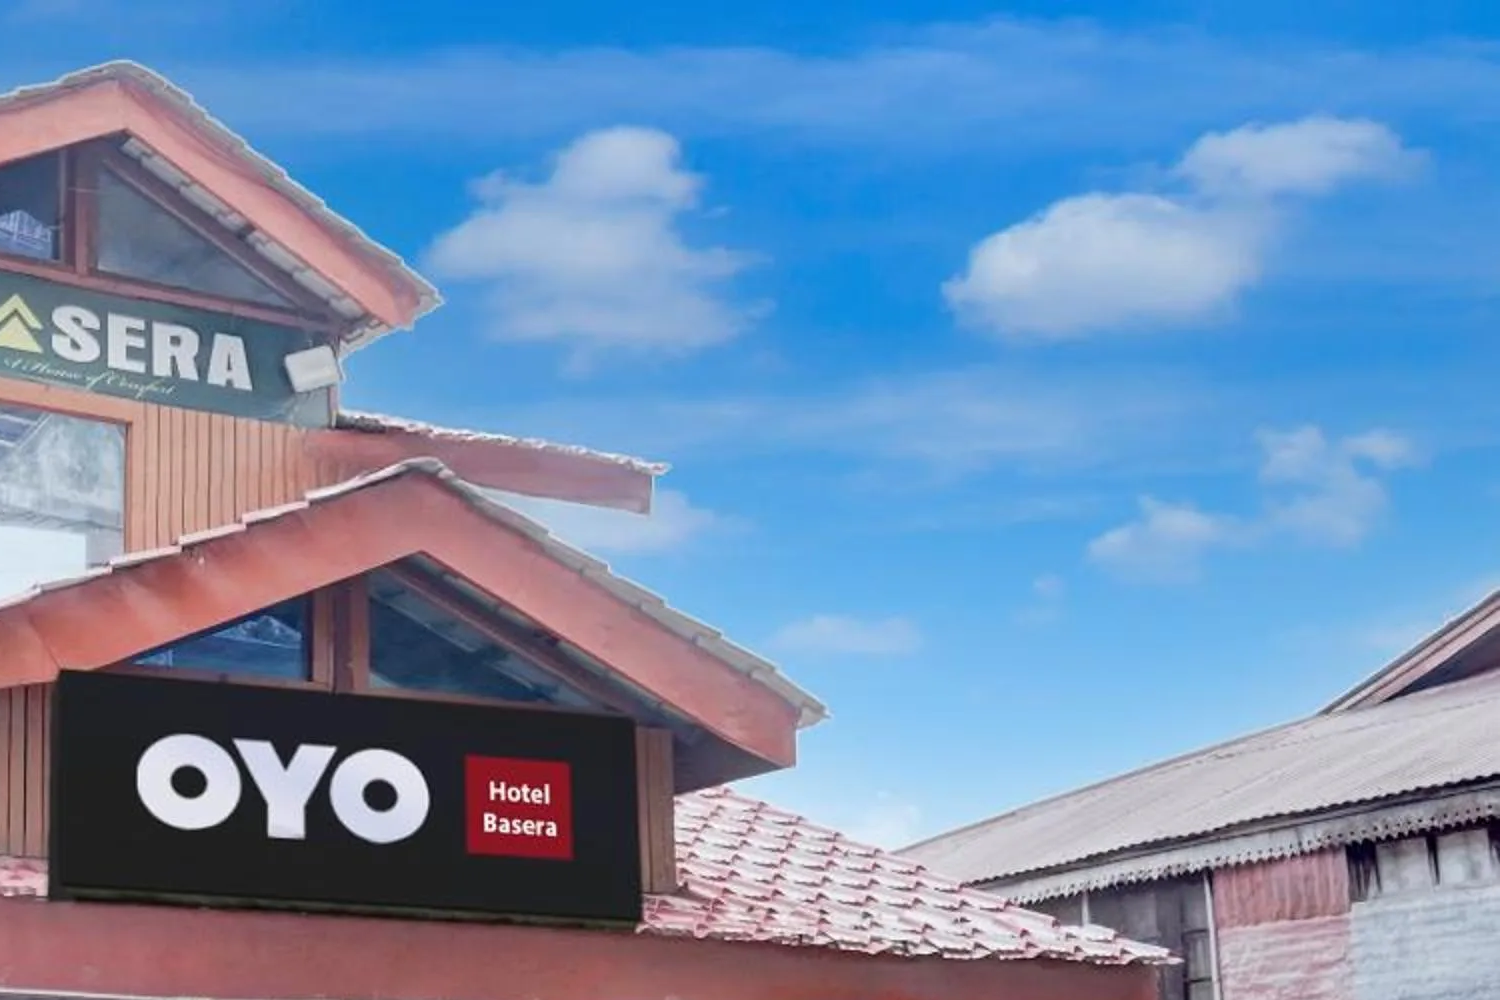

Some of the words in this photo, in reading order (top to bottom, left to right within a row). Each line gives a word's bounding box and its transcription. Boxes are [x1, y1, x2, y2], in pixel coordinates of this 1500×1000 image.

[136, 733, 430, 844] OYO
[489, 780, 551, 805] Hotel
[483, 812, 557, 837] Basera
